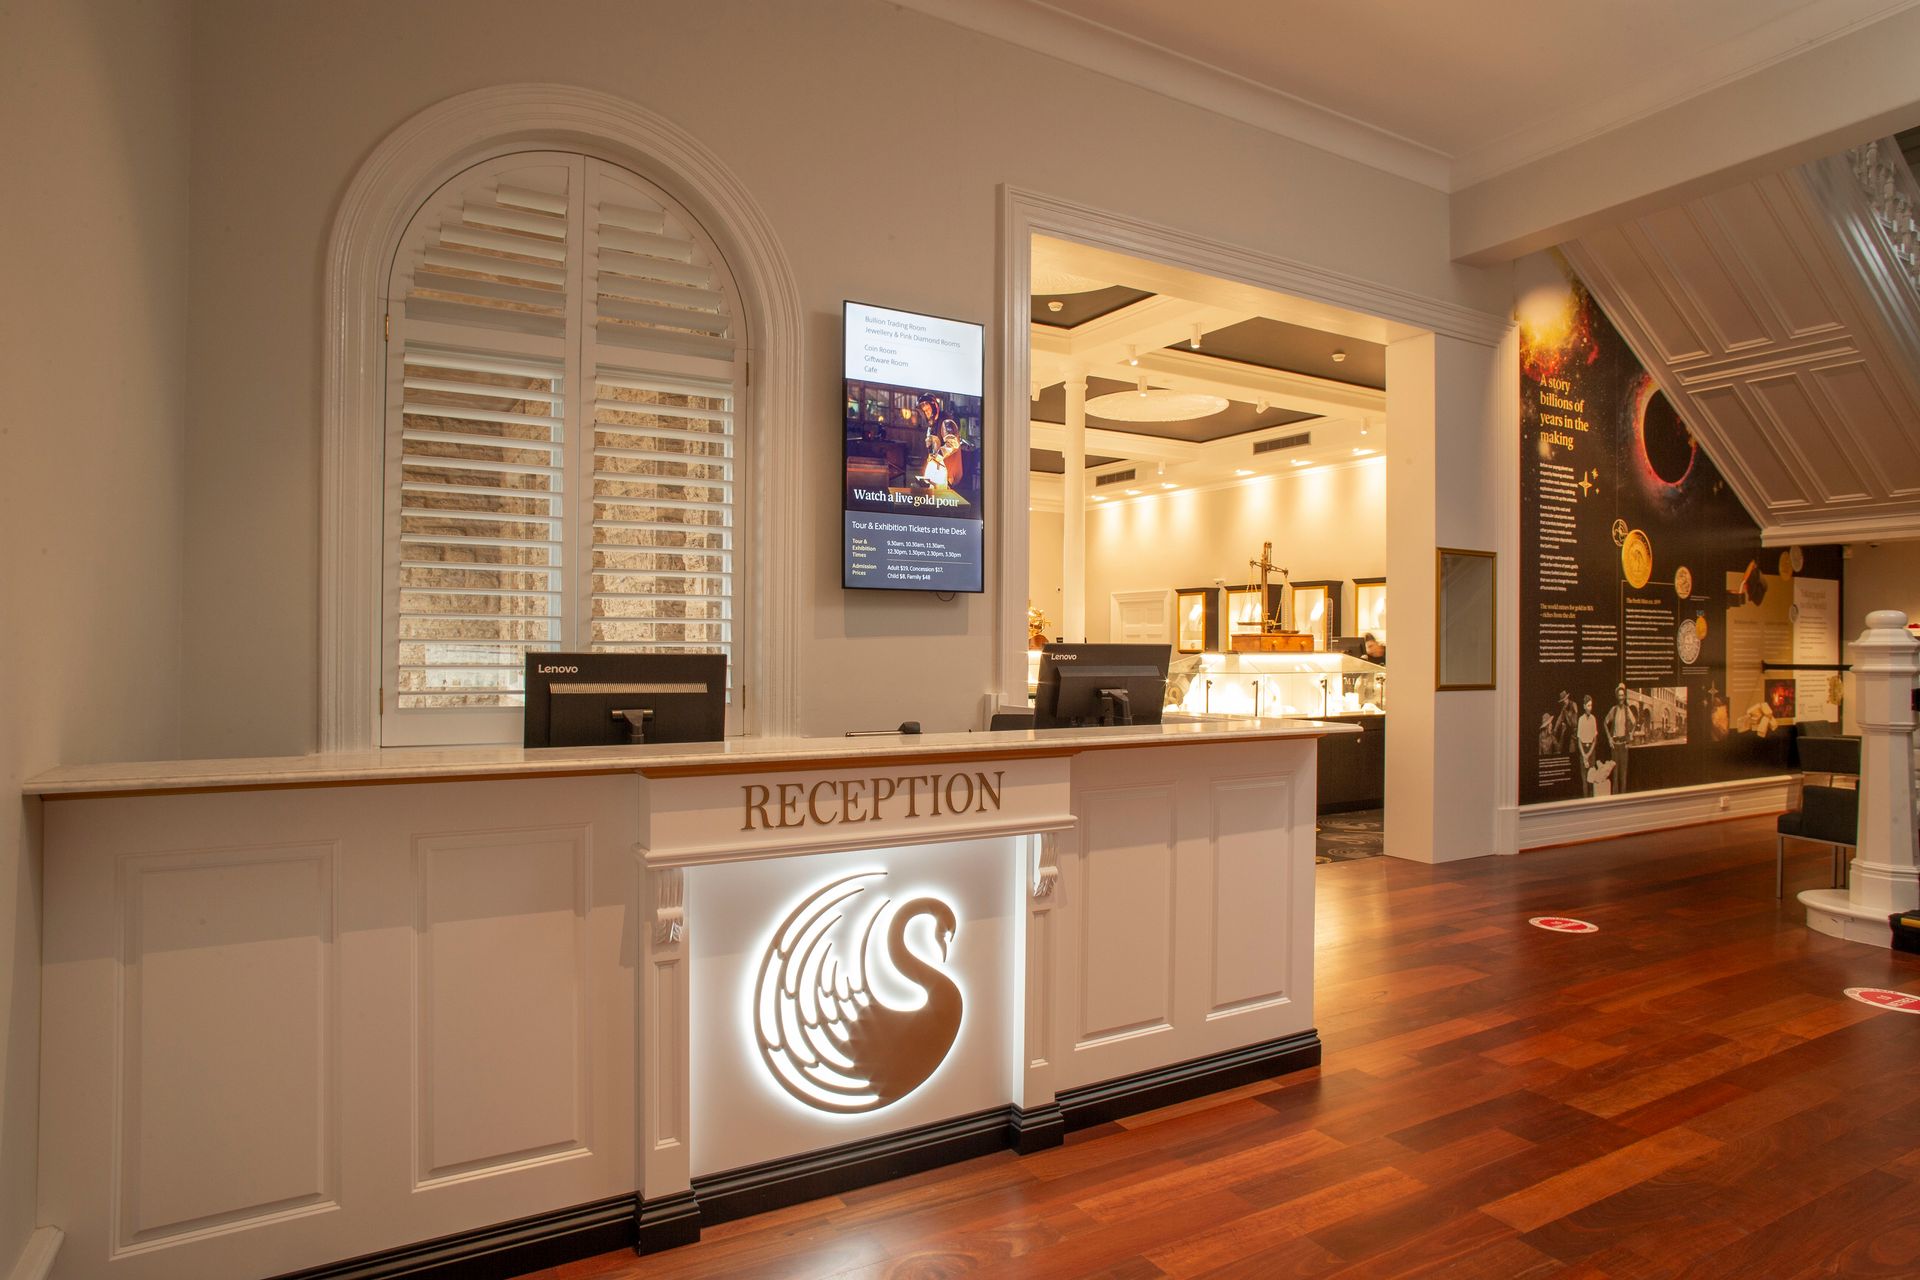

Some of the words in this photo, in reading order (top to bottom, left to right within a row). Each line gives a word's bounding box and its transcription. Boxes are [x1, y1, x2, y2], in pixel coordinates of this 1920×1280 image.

[865, 316, 886, 326] Bullion
[887, 319, 908, 330] Trading
[909, 324, 927, 332] Room
[865, 327, 893, 338] Jewellery
[900, 332, 912, 341] Pink
[913, 334, 941, 345] Diamond
[941, 338, 961, 348] Rooms
[864, 344, 878, 352] Coin
[879, 346, 897, 355] Room
[864, 355, 890, 365] Giftware
[890, 359, 909, 367] Room
[1540, 374, 1548, 386] A
[1549, 378, 1571, 395] story
[1540, 391, 1573, 410] billions
[1574, 399, 1585, 413] of
[1540, 413, 1563, 427] years
[1564, 414, 1573, 428] in
[1574, 418, 1589, 432] the
[1540, 431, 1574, 451] making
[854, 489, 886, 502] Watch
[895, 492, 913, 503] live
[914, 494, 935, 507] gold
[936, 497, 960, 508] pour
[852, 521, 867, 530] Tour
[868, 522, 874, 530] &
[874, 522, 907, 532] Exhibition
[909, 525, 931, 534] Tickets
[940, 527, 950, 535] the
[951, 528, 967, 536] Desk
[1050, 652, 1077, 661] Lenovo
[538, 664, 579, 674] Lenovo
[741, 771, 1005, 831] RECEPTION
